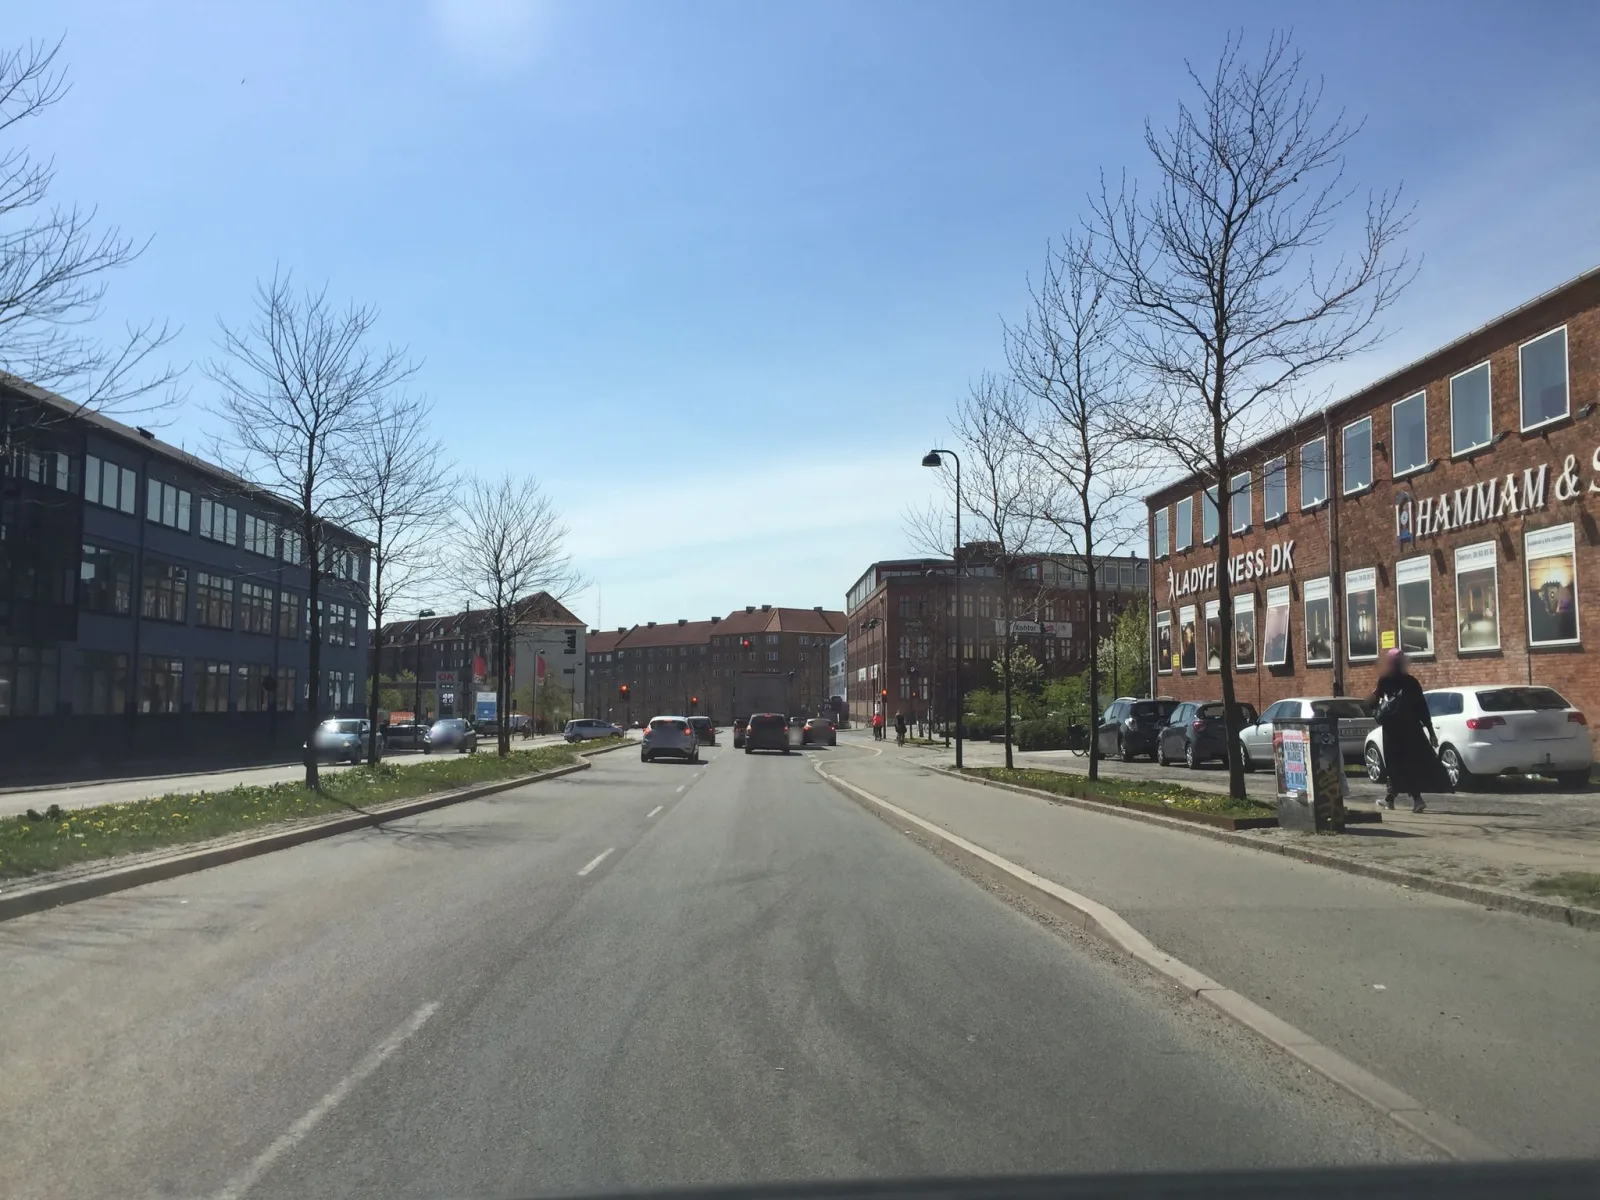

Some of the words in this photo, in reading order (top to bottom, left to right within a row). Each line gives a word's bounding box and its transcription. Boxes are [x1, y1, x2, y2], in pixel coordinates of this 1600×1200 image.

[1416, 463, 1548, 537] HAMMAM
[1555, 454, 1580, 501] &
[1175, 540, 1295, 597] LADYFINESS.DK
